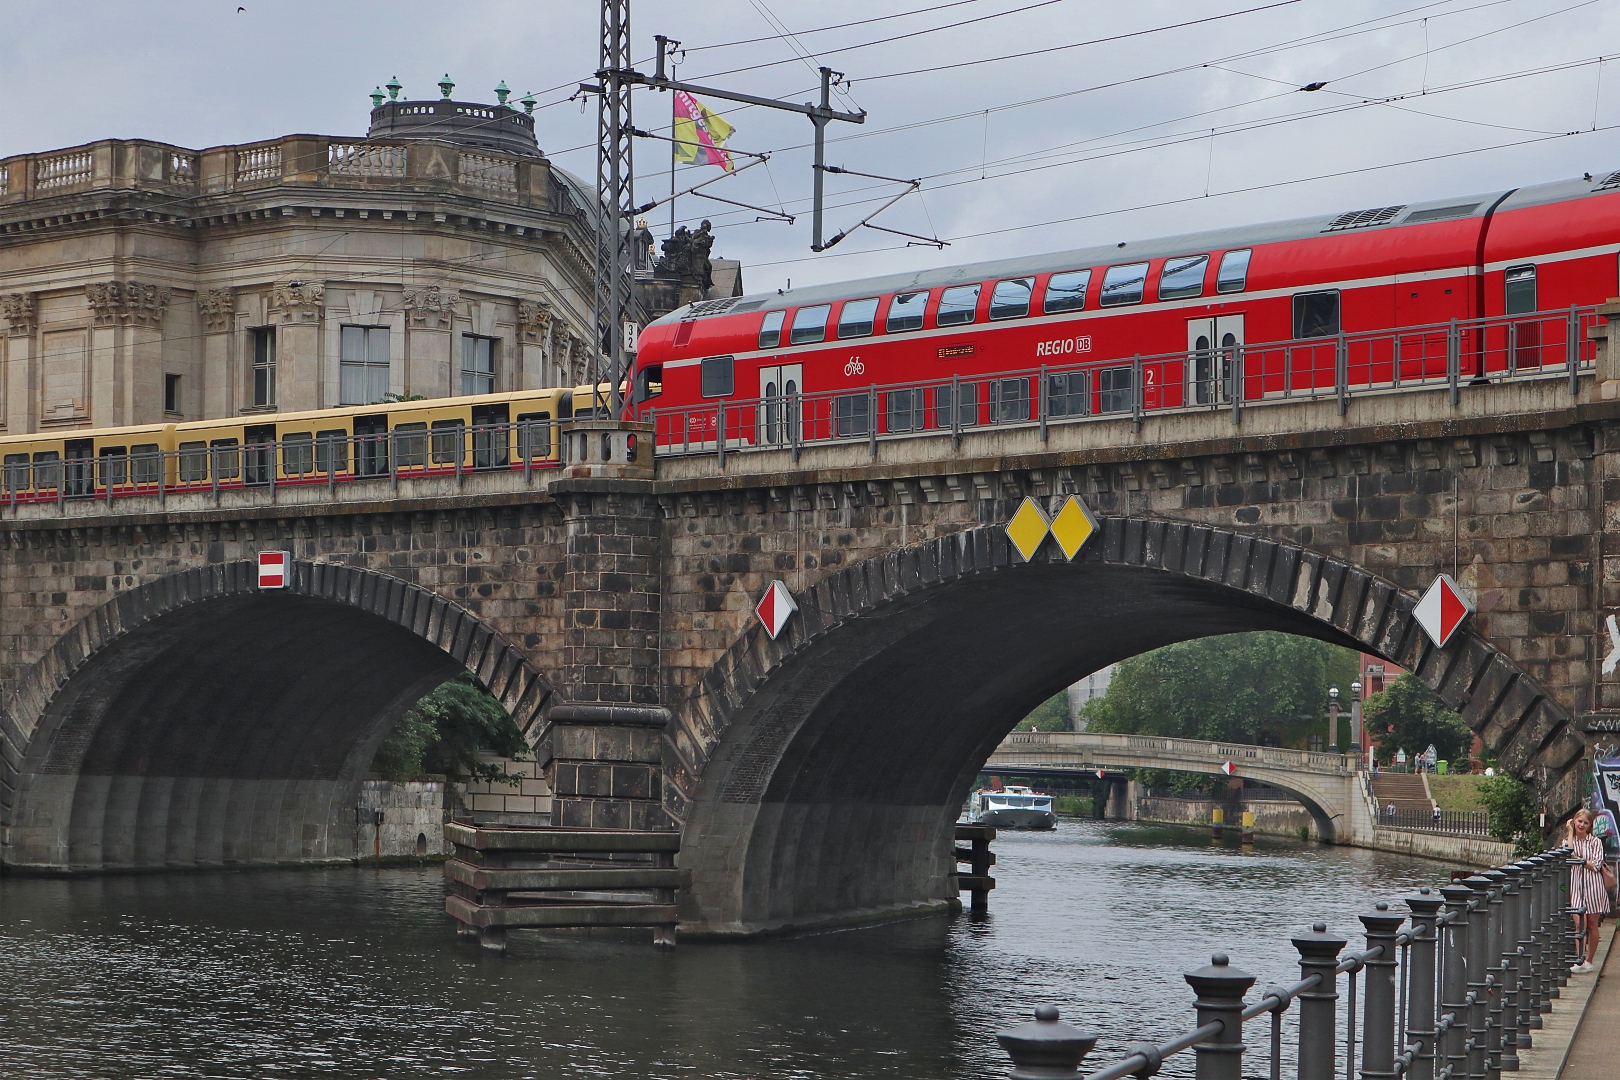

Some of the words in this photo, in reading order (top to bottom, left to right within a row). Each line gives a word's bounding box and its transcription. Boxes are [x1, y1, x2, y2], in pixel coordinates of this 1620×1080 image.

[1036, 338, 1074, 356] REGIO
[1077, 336, 1091, 351] DB
[1146, 369, 1154, 385] 2
